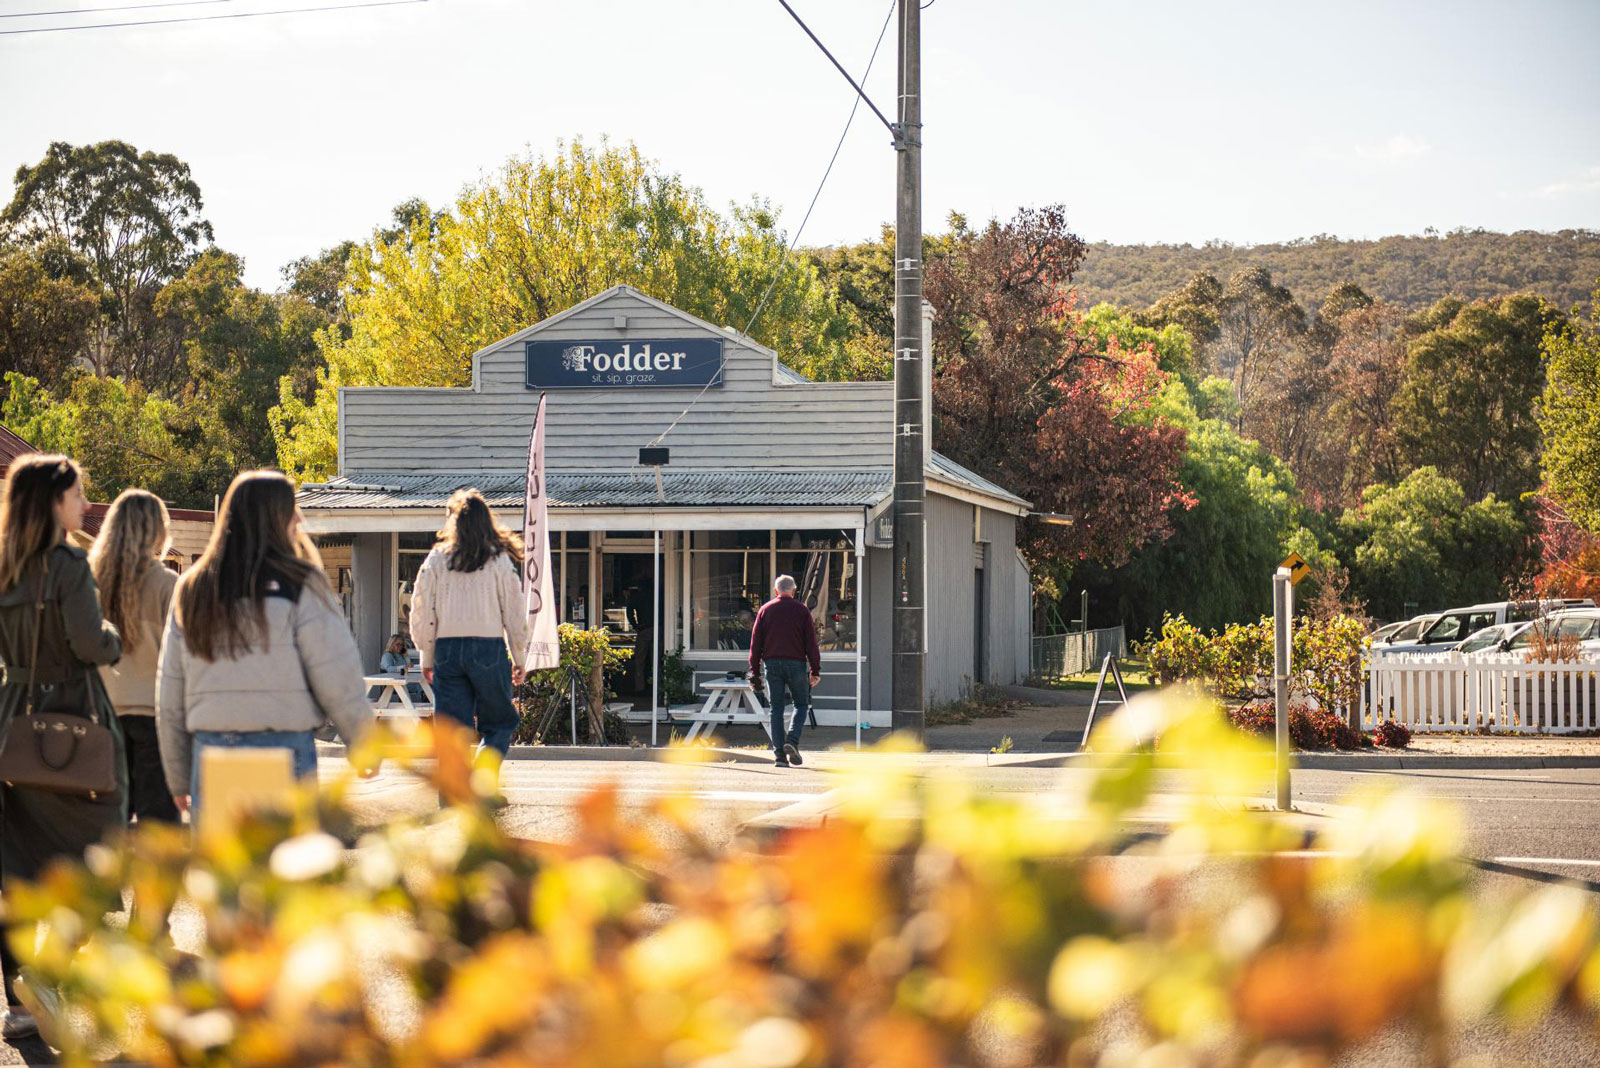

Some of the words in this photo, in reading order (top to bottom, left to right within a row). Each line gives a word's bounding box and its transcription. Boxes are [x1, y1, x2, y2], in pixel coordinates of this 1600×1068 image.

[573, 344, 686, 371] Fodder
[607, 373, 622, 385] sip.
[625, 374, 656, 385] graze.
